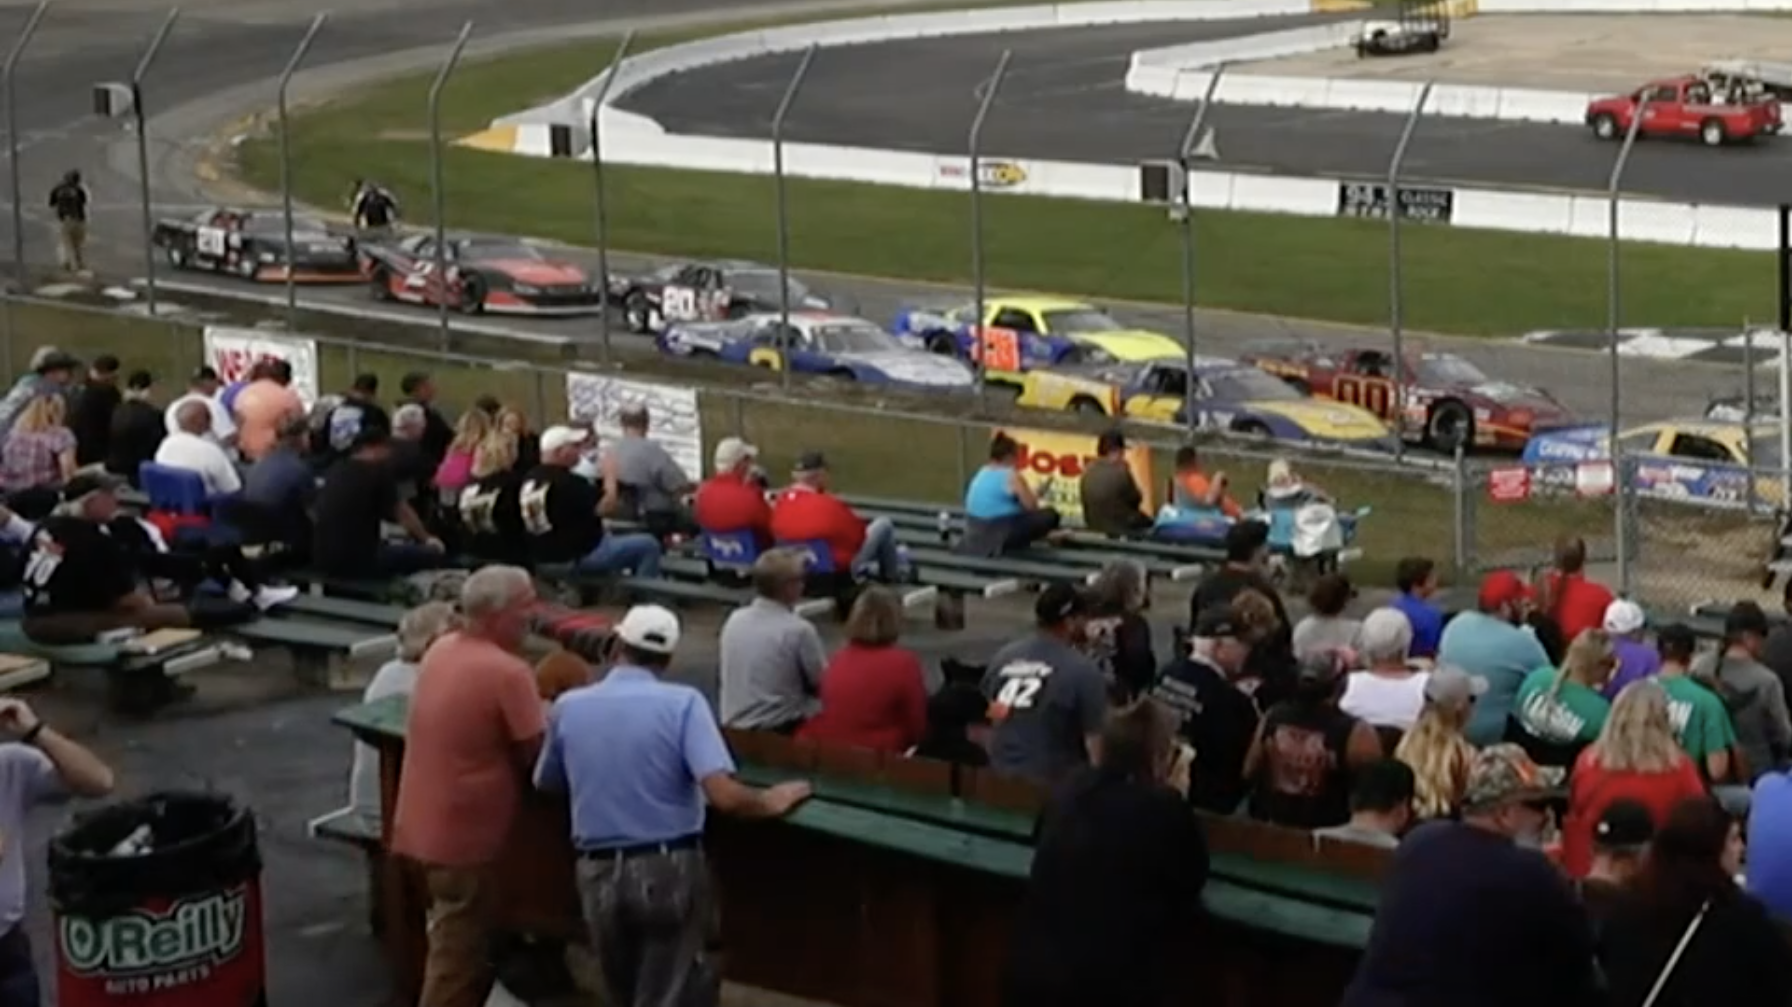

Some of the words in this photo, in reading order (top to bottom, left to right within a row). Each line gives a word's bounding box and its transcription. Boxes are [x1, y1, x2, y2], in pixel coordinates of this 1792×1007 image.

[997, 676, 1043, 709] 42
[63, 895, 245, 969] OReilly
[153, 965, 210, 990] PARTS
